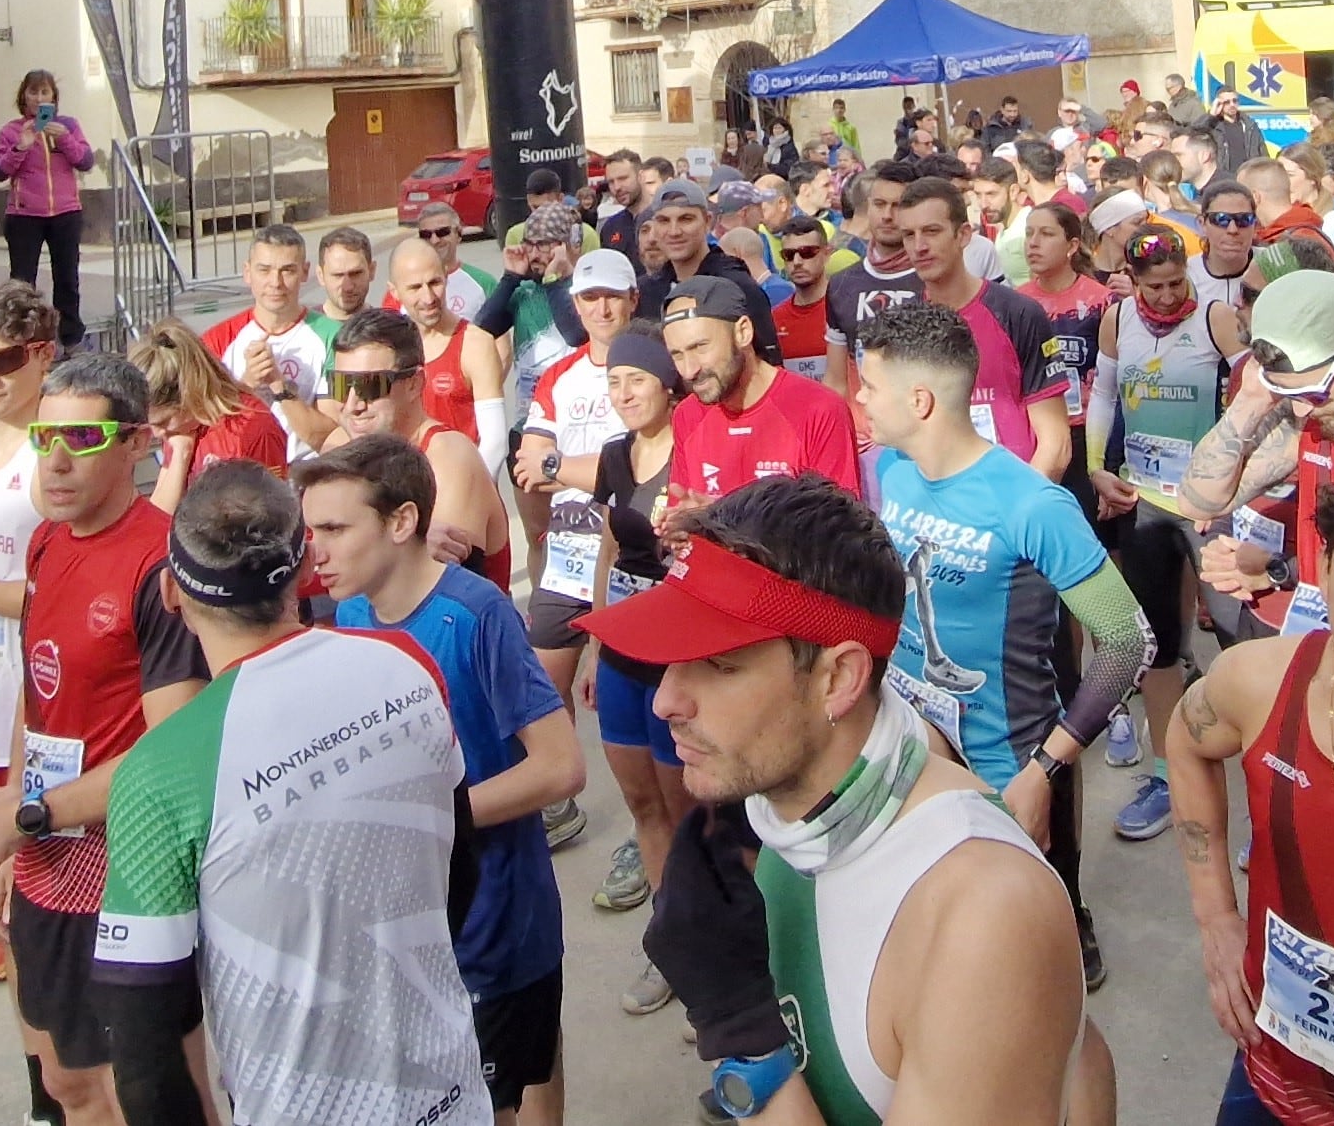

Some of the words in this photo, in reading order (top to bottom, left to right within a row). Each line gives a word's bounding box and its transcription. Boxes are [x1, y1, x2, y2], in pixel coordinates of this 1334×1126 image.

[771, 76, 792, 89] Club
[1122, 364, 1164, 387] Sport
[1144, 456, 1161, 473] 71
[565, 559, 585, 575] 92
[360, 709, 383, 731] DE
[253, 705, 447, 825] BARBASTRO
